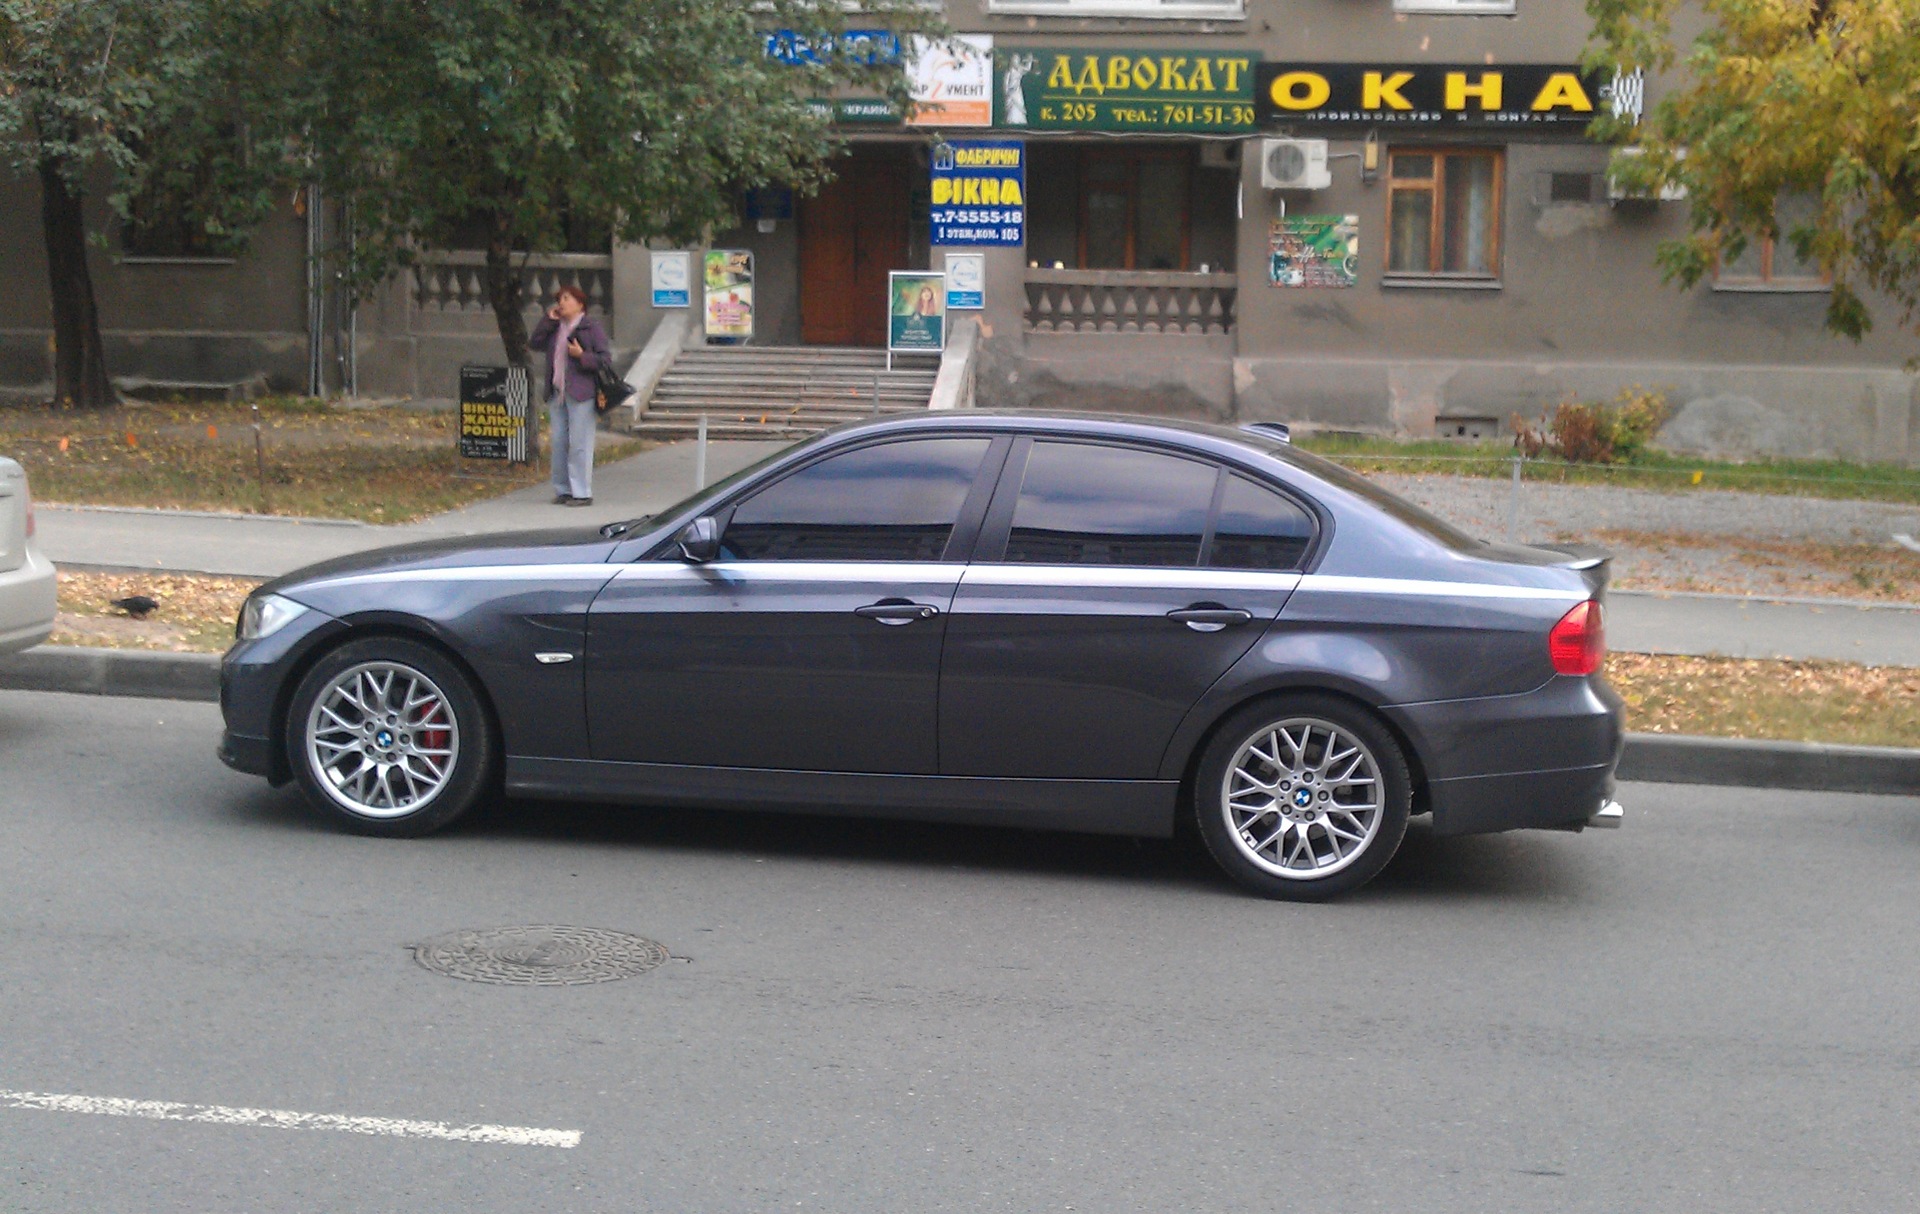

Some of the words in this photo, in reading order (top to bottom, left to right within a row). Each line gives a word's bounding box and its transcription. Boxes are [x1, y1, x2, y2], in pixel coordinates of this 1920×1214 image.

[1047, 54, 1249, 95] АДВОКАТ
[1269, 71, 1594, 112] ОКНА
[1062, 103, 1097, 121] 205
[1163, 104, 1255, 125] 761-51-30
[1306, 111, 1442, 122] ПРОИЗВОДСТВО
[932, 178, 1023, 205] ВІКНА
[1001, 228, 1020, 241] 105
[462, 402, 507, 416] ВІКНА
[462, 425, 517, 438] РОЛЕТИ
